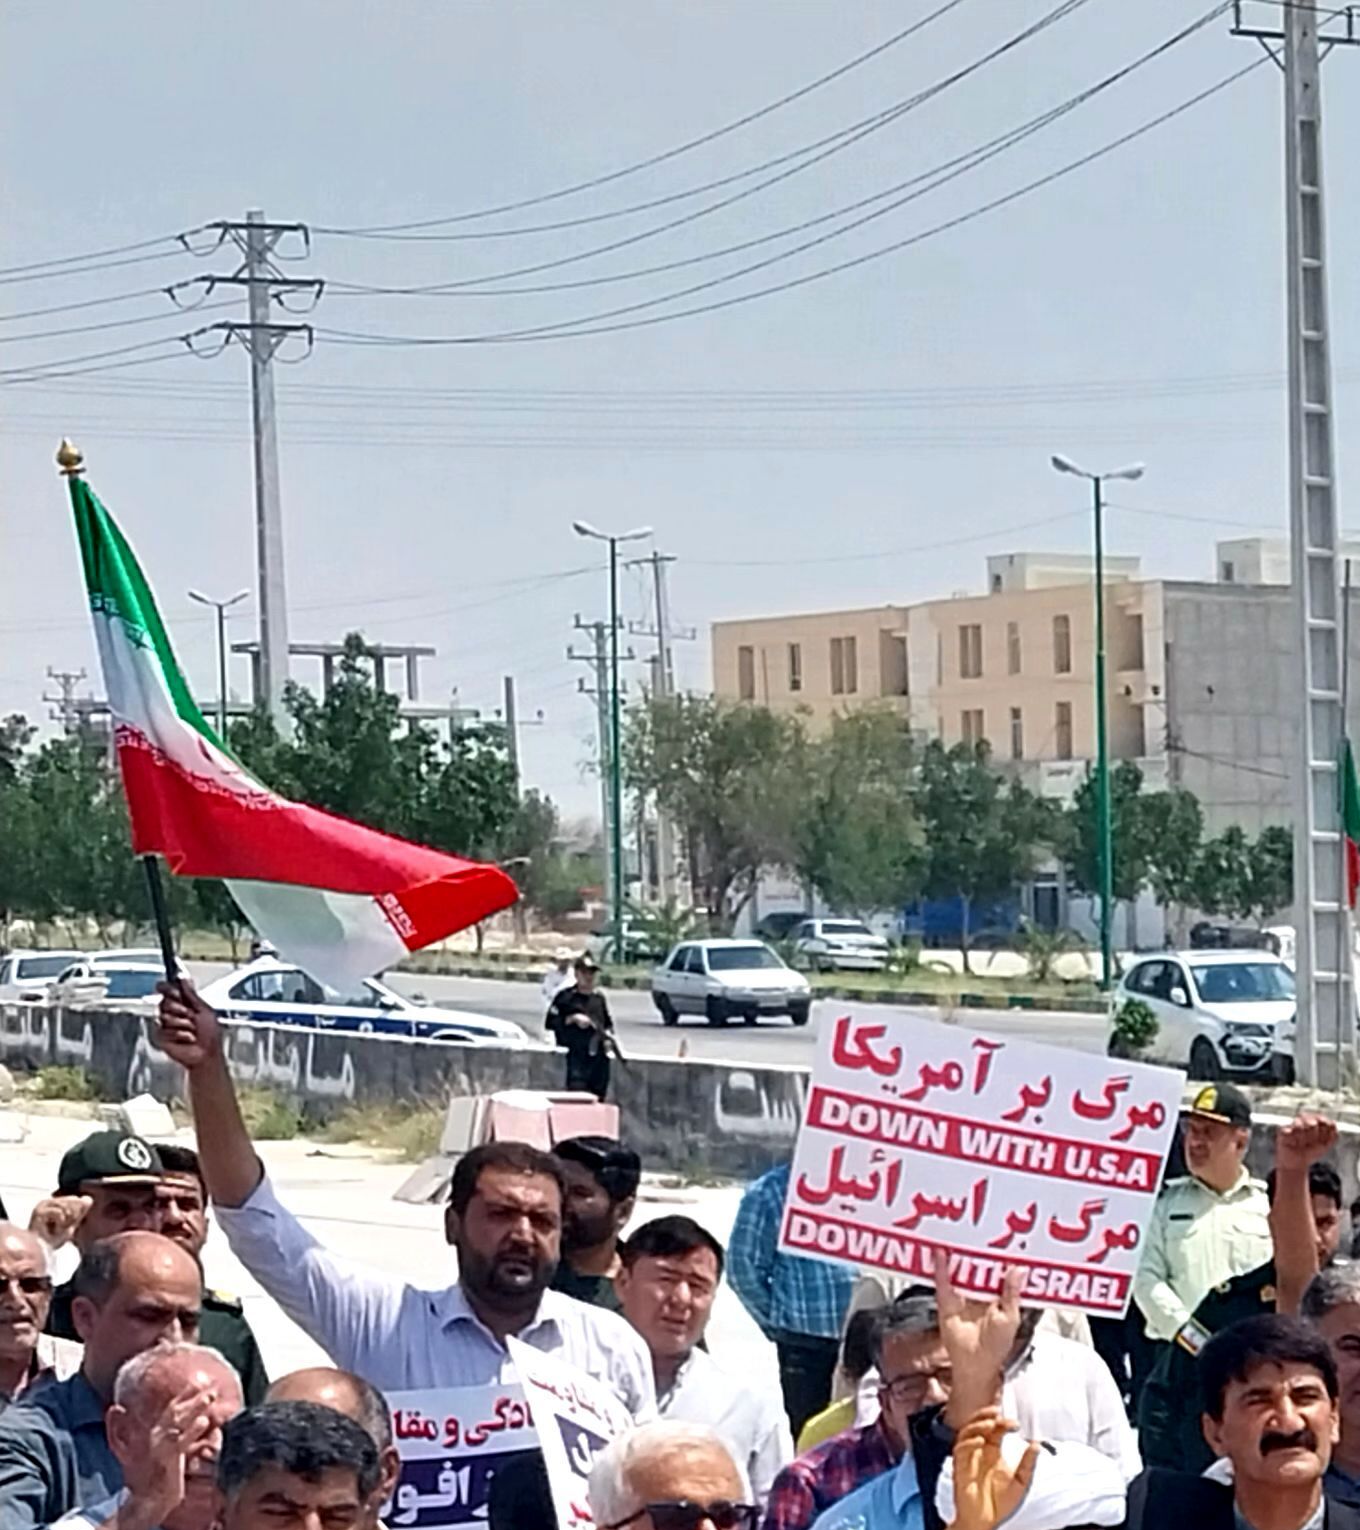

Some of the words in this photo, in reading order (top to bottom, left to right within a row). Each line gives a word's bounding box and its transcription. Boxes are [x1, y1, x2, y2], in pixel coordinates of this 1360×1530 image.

[831, 1016, 1006, 1100] آمریکا
[1001, 1075, 1052, 1125] بر
[1072, 1076, 1167, 1141] مرگ
[820, 1096, 947, 1149] DOWN
[960, 1126, 1055, 1170] WITH
[1065, 1153, 1150, 1187] U.S.A
[796, 1145, 989, 1230] اسرائیل
[788, 1215, 915, 1268] DOWN
[988, 1202, 1038, 1250] بر
[1048, 1197, 1141, 1263] مرگ
[442, 1416, 459, 1448] و
